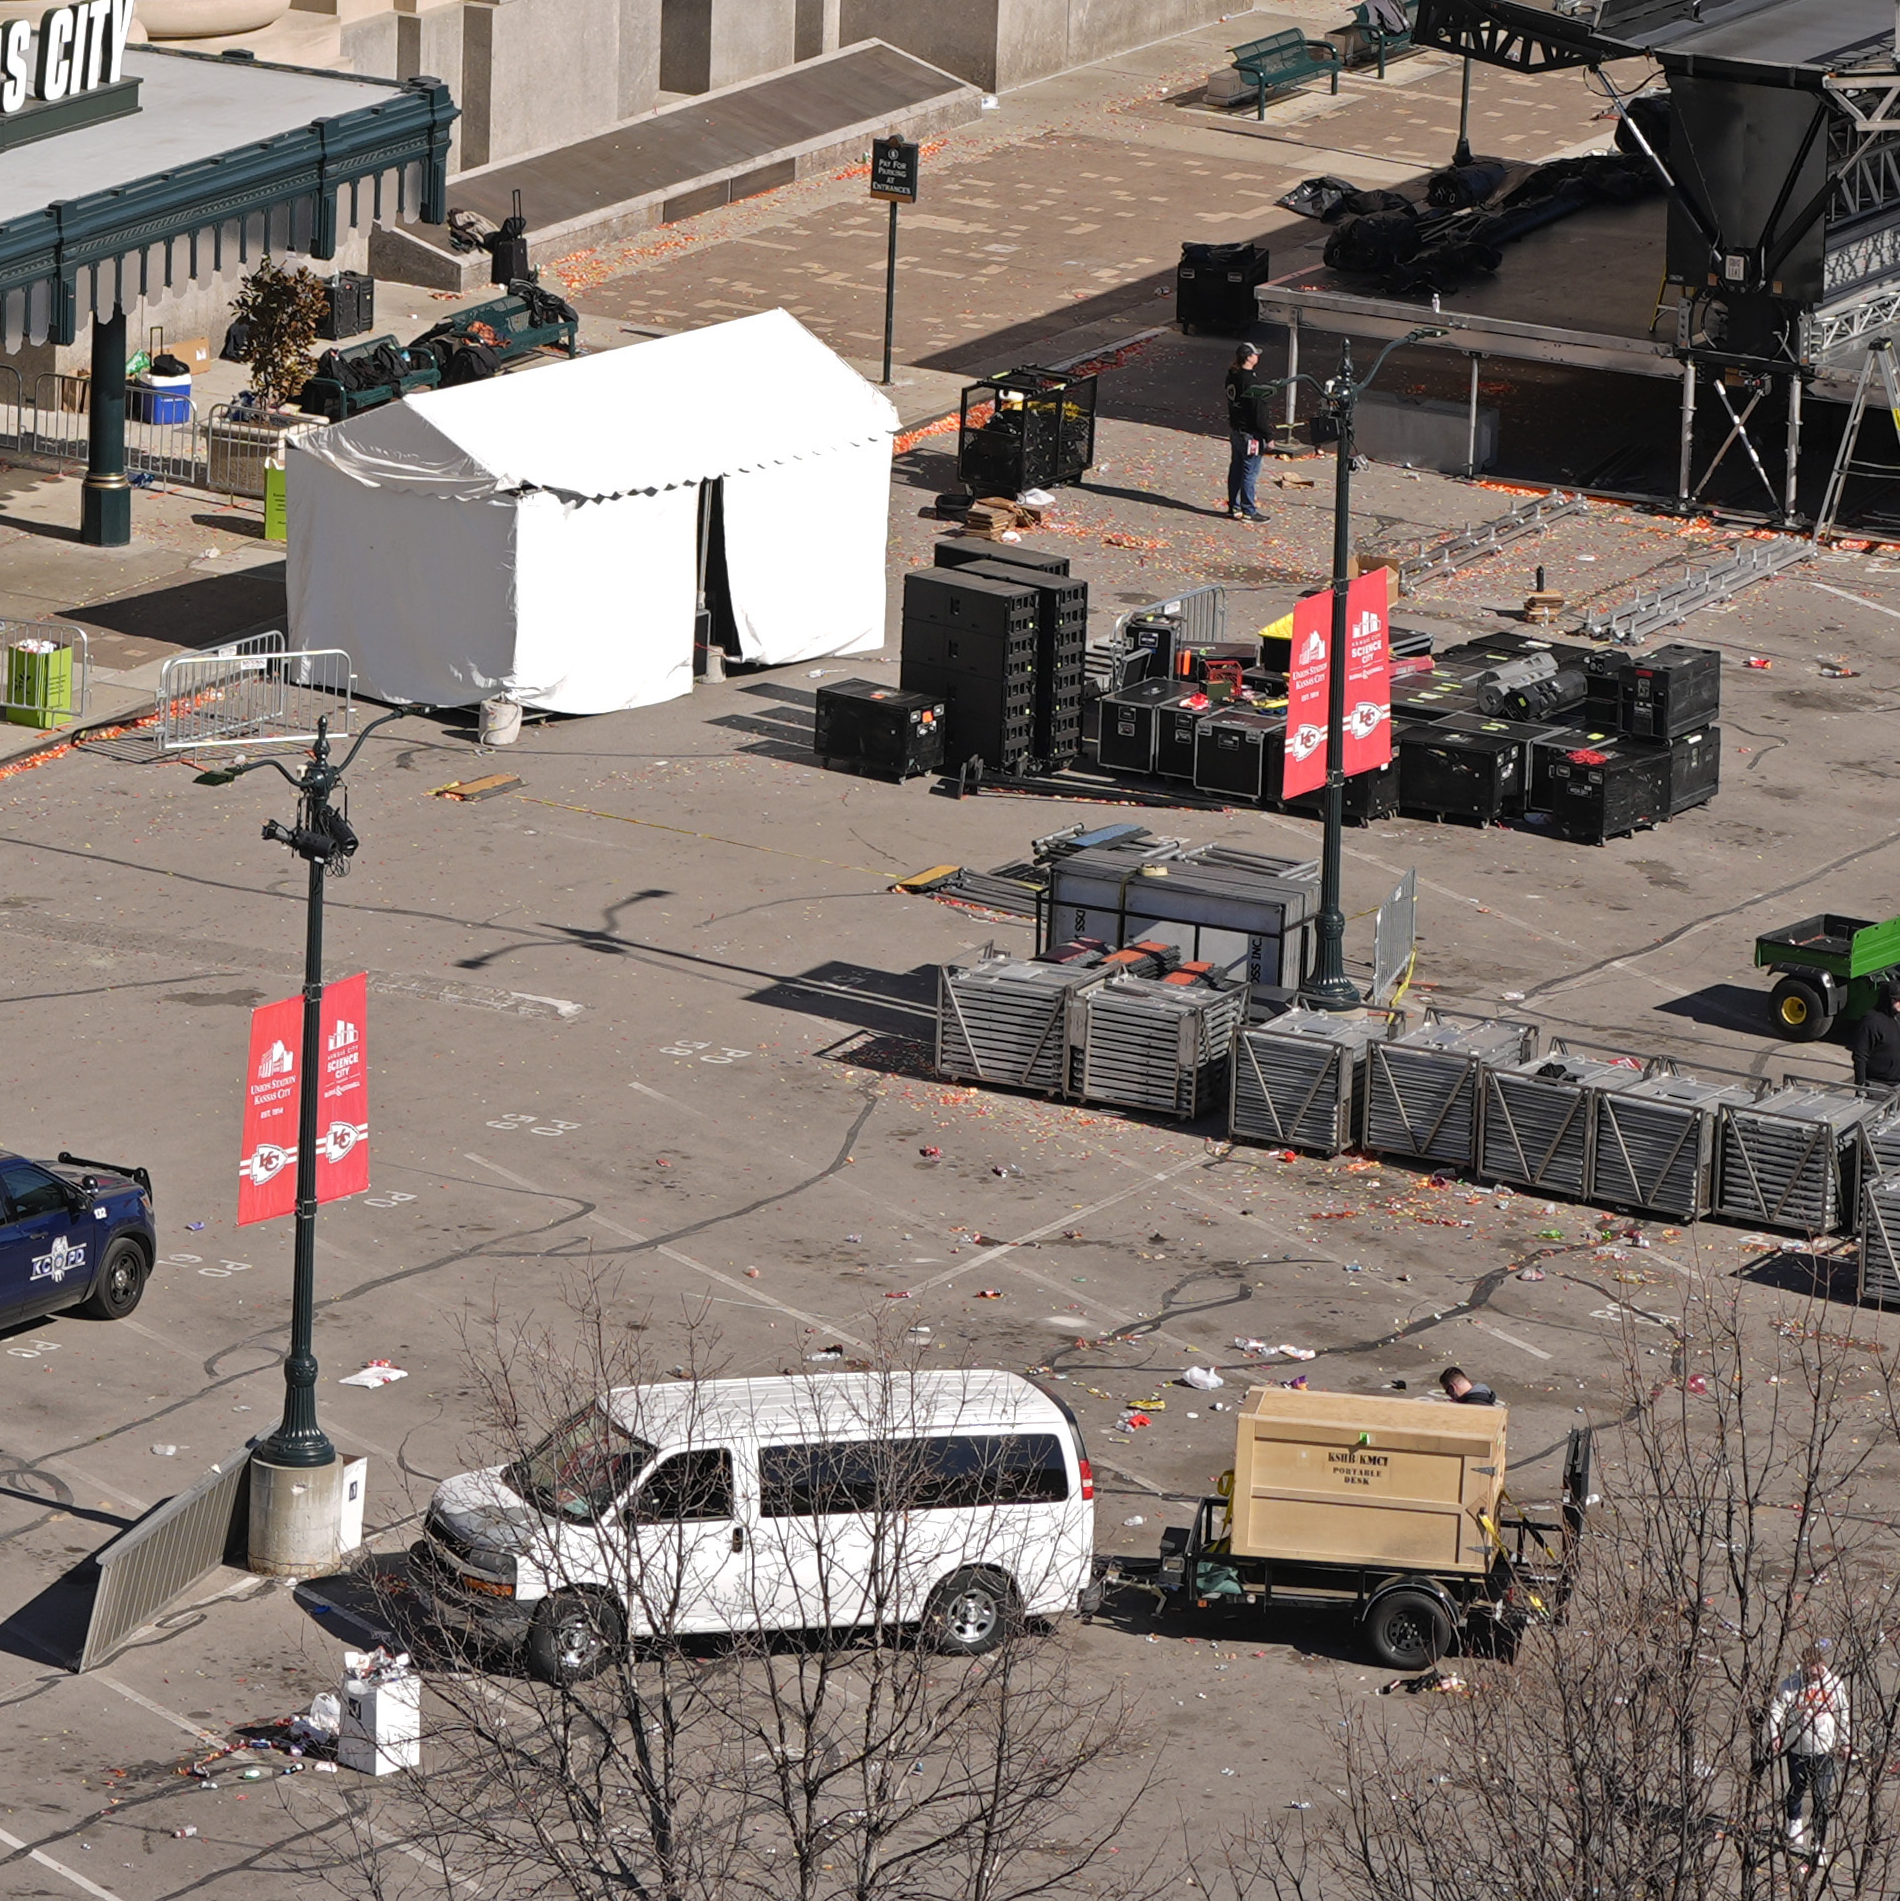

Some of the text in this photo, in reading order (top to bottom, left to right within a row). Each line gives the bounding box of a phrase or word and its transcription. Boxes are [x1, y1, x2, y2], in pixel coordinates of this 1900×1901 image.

[879, 158, 907, 170] PAY FOR
[878, 167, 907, 178] PARKING
[886, 176, 896, 184] AT
[872, 181, 911, 195] ENTRANCES
[1351, 640, 1382, 659] SCIENCE
[1361, 652, 1374, 665] CITY
[1252, 937, 1262, 961] INC.
[327, 1051, 359, 1073] SCIENCE
[335, 1065, 350, 1079] CITY
[250, 1074, 297, 1096] UNION STATION
[253, 1087, 292, 1106] KANSAS CITY
[333, 1127, 351, 1150] KC
[259, 1150, 280, 1173] KC
[93, 1207, 108, 1220] 132
[31, 1248, 86, 1276] KC PD
[1332, 1466, 1382, 1478] PORTABLE
[1344, 1476, 1370, 1486] DESK
